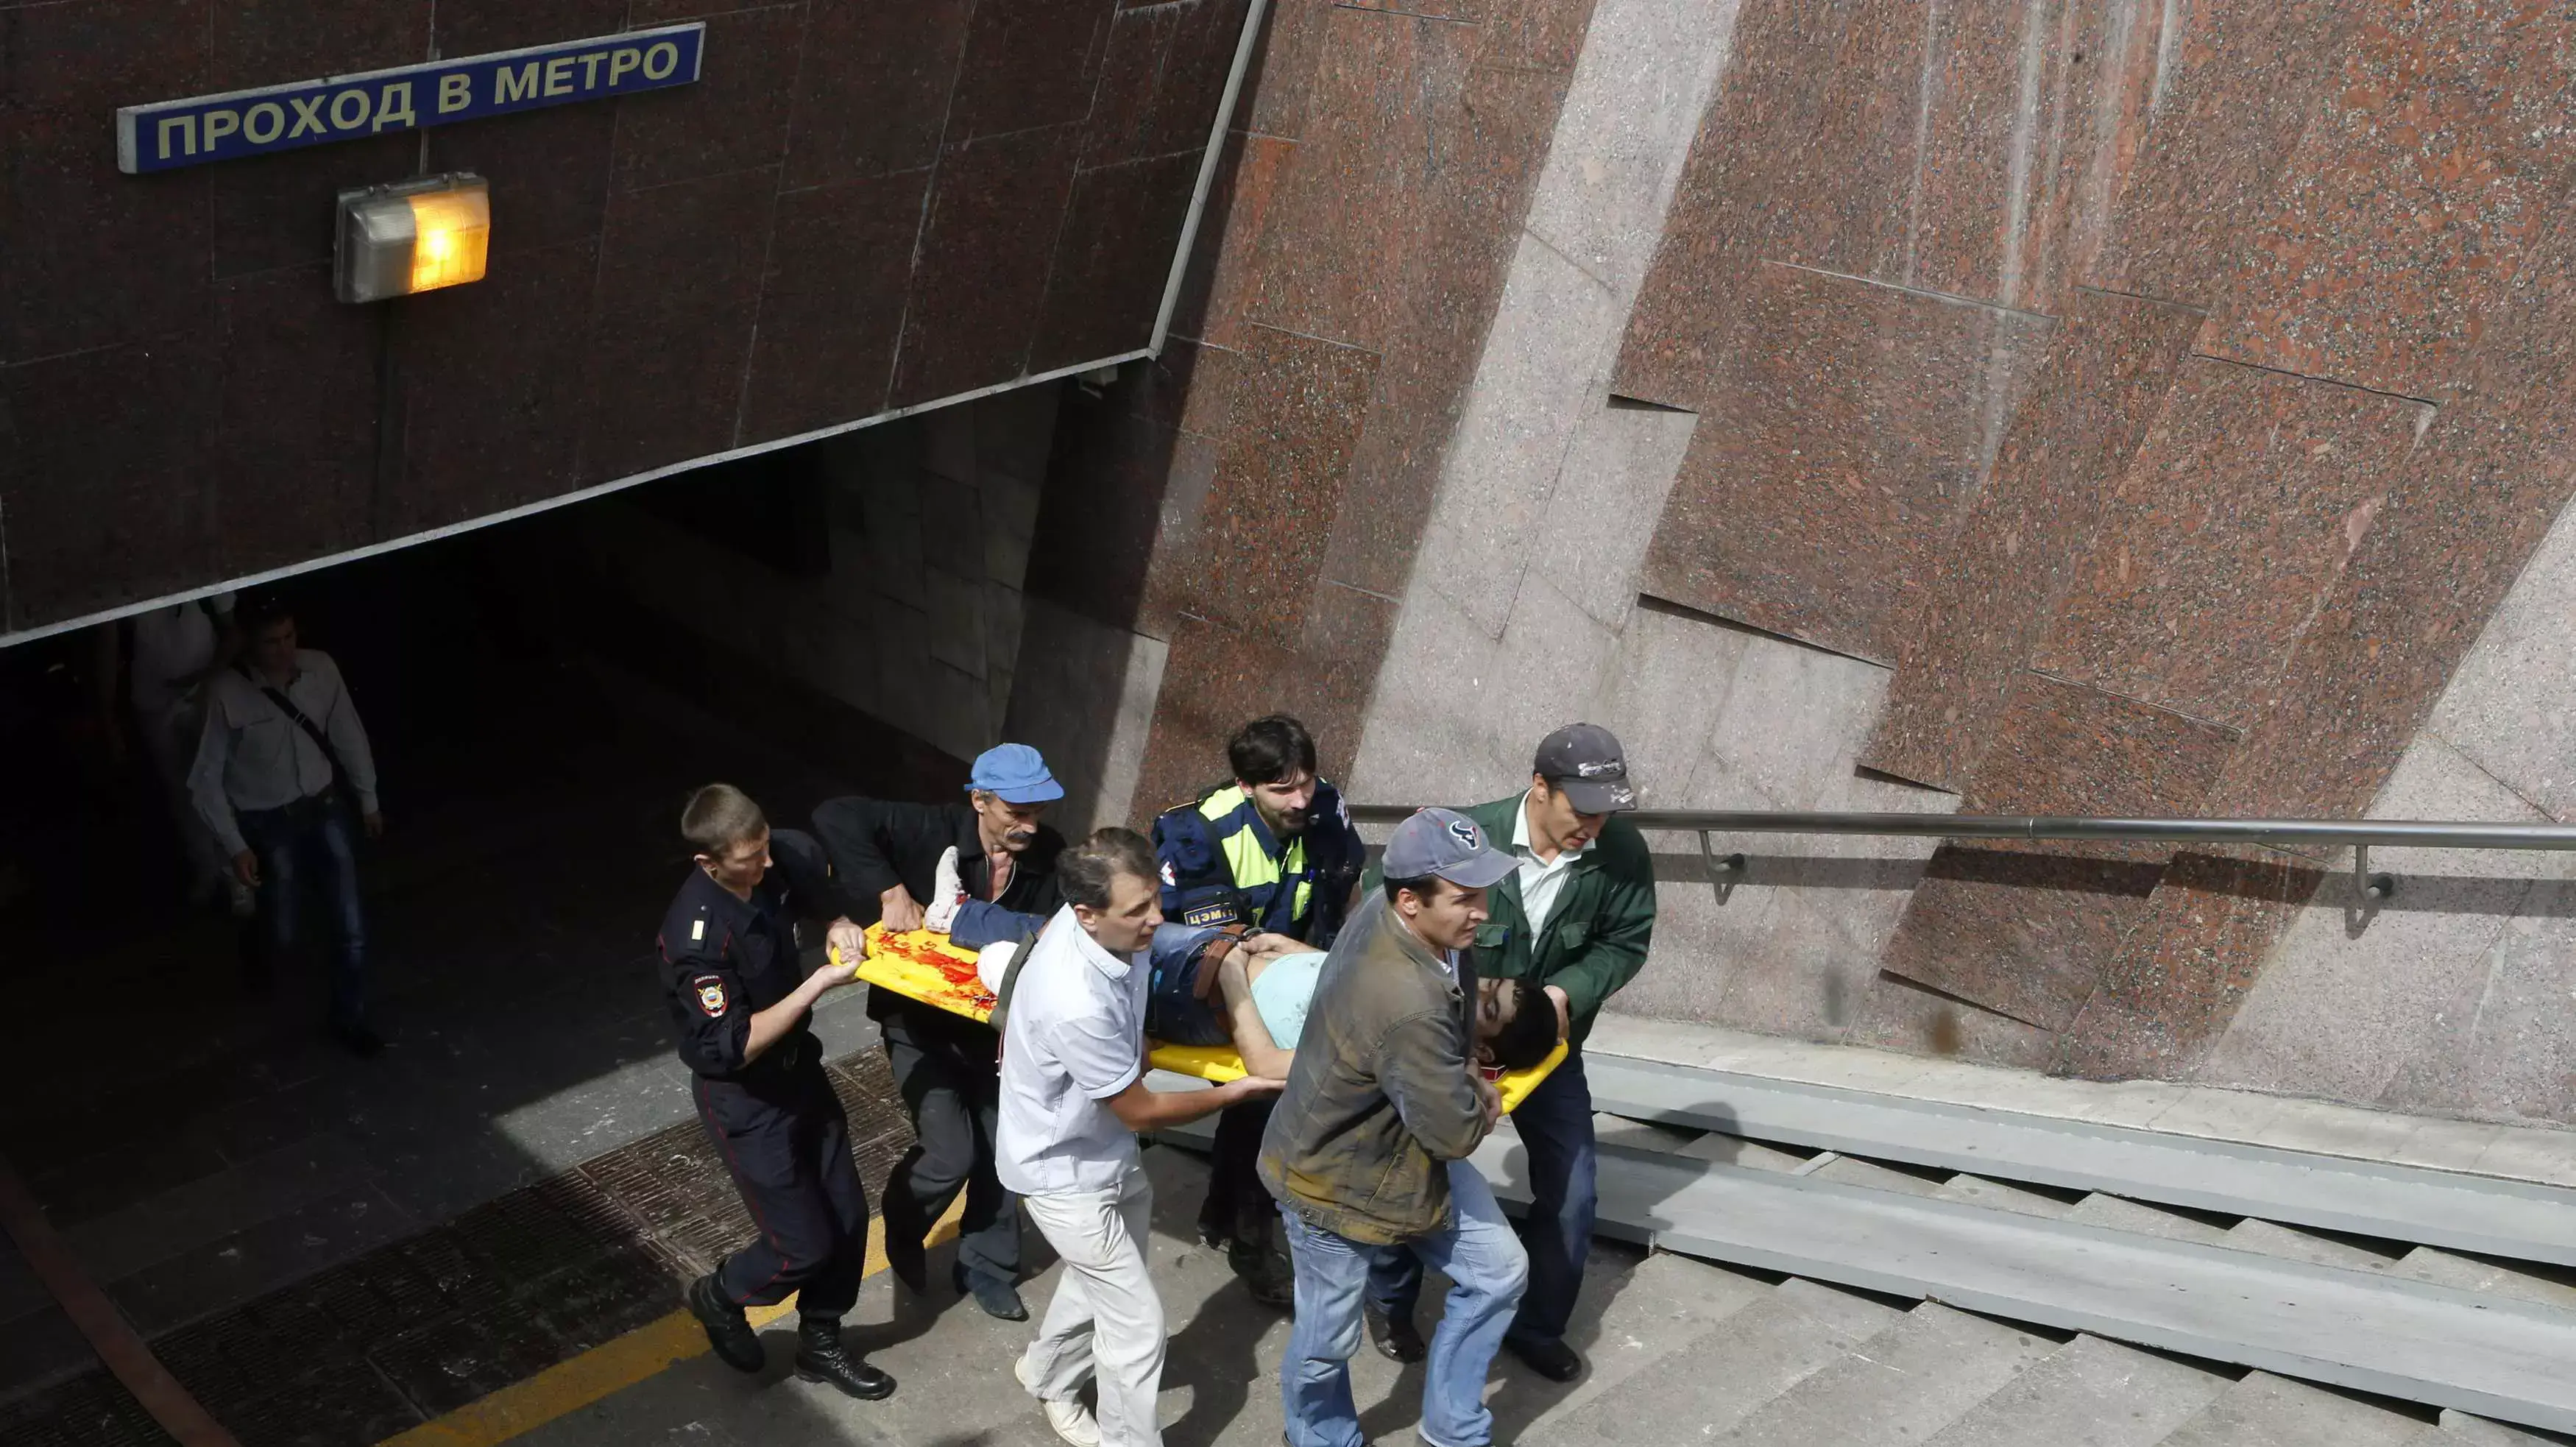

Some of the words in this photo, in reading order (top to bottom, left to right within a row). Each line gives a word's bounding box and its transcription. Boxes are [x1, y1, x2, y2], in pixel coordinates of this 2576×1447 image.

[158, 82, 415, 159] ПРОХОД
[439, 73, 472, 114] В
[495, 42, 679, 105] МЕТРО
